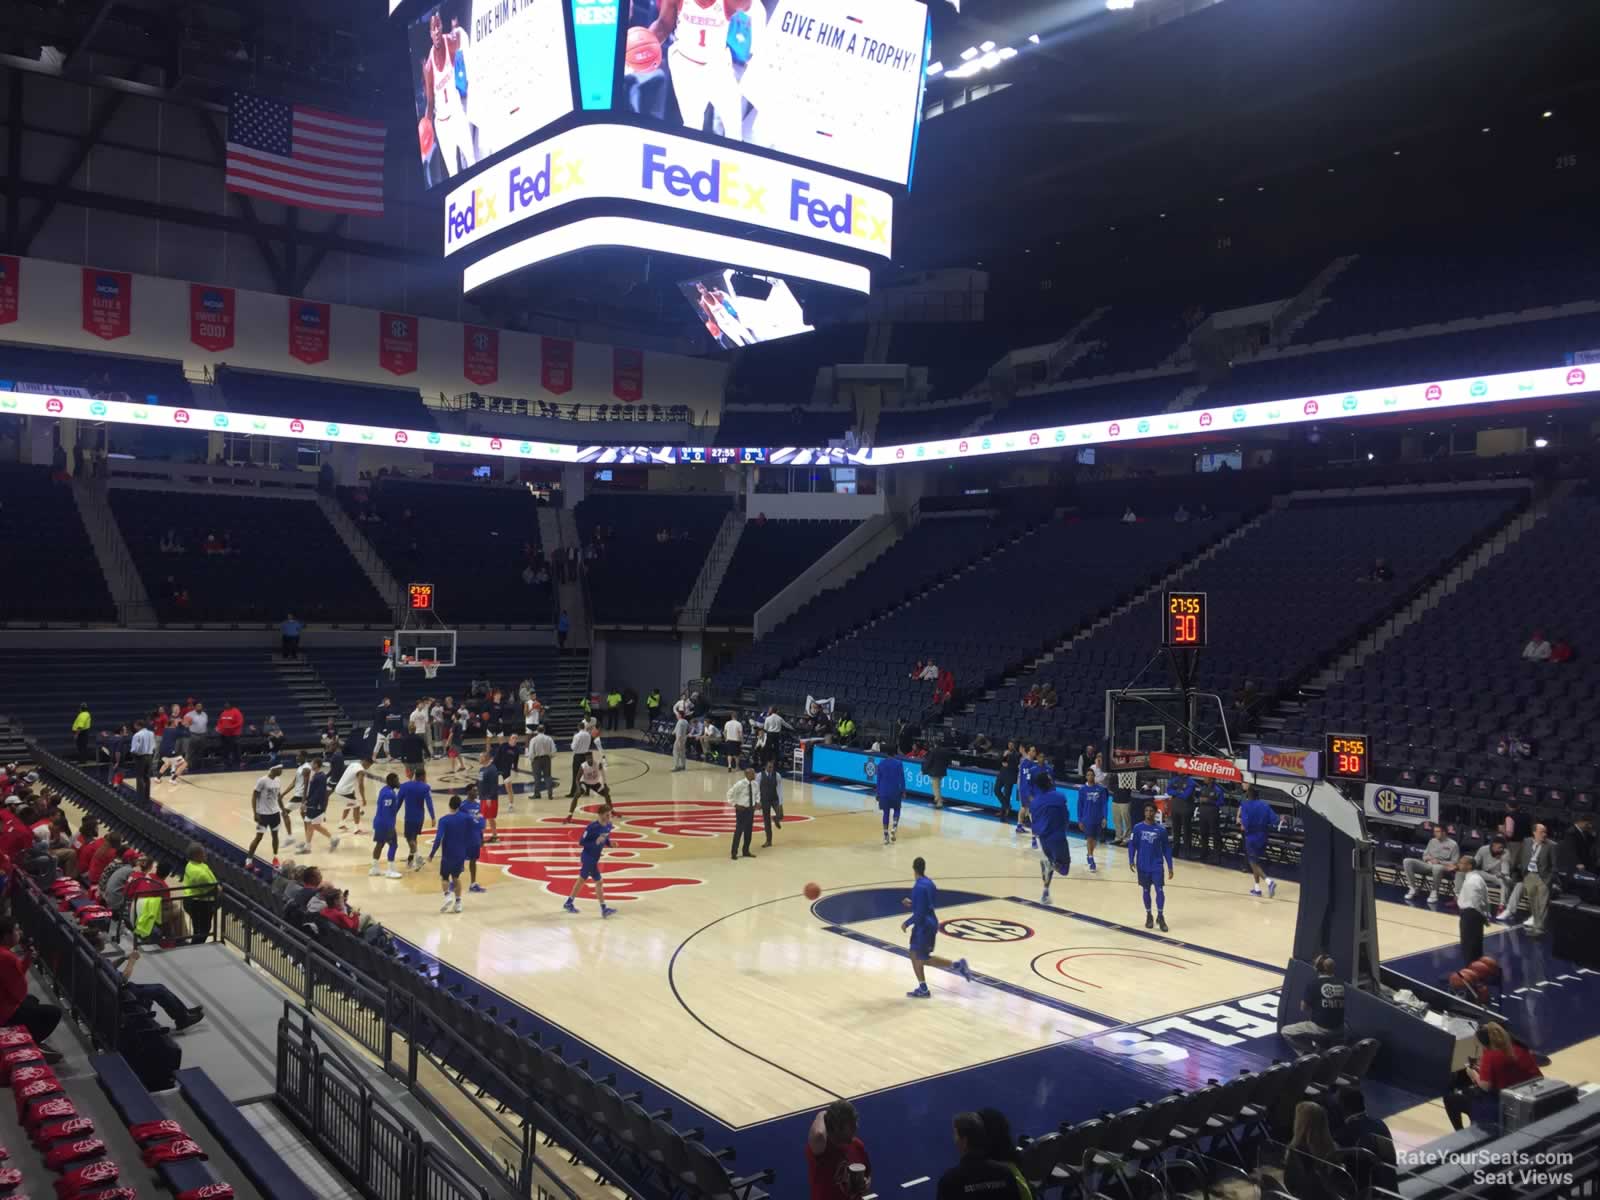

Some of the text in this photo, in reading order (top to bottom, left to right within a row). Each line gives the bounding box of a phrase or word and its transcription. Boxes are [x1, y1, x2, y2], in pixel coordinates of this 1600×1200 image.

[476, 10, 493, 42] GIVE
[699, 29, 706, 48] 1
[781, 11, 916, 73] GIVE HIM A TROPHY!
[509, 148, 585, 213] FedEx
[642, 143, 768, 215] FedEx
[448, 187, 497, 244] FedEx
[790, 178, 888, 244] FedEx
[199, 324, 227, 338] 2001
[410, 586, 431, 594] 27:55
[413, 594, 428, 608] 30
[1170, 598, 1200, 614] 27:55
[1175, 615, 1197, 642] 30
[1333, 740, 1364, 755] 27:55
[1263, 753, 1305, 769] SONIC
[1339, 755, 1360, 773] 30
[948, 777, 960, 791] to
[963, 777, 978, 794] be
[1377, 790, 1398, 812] SEC
